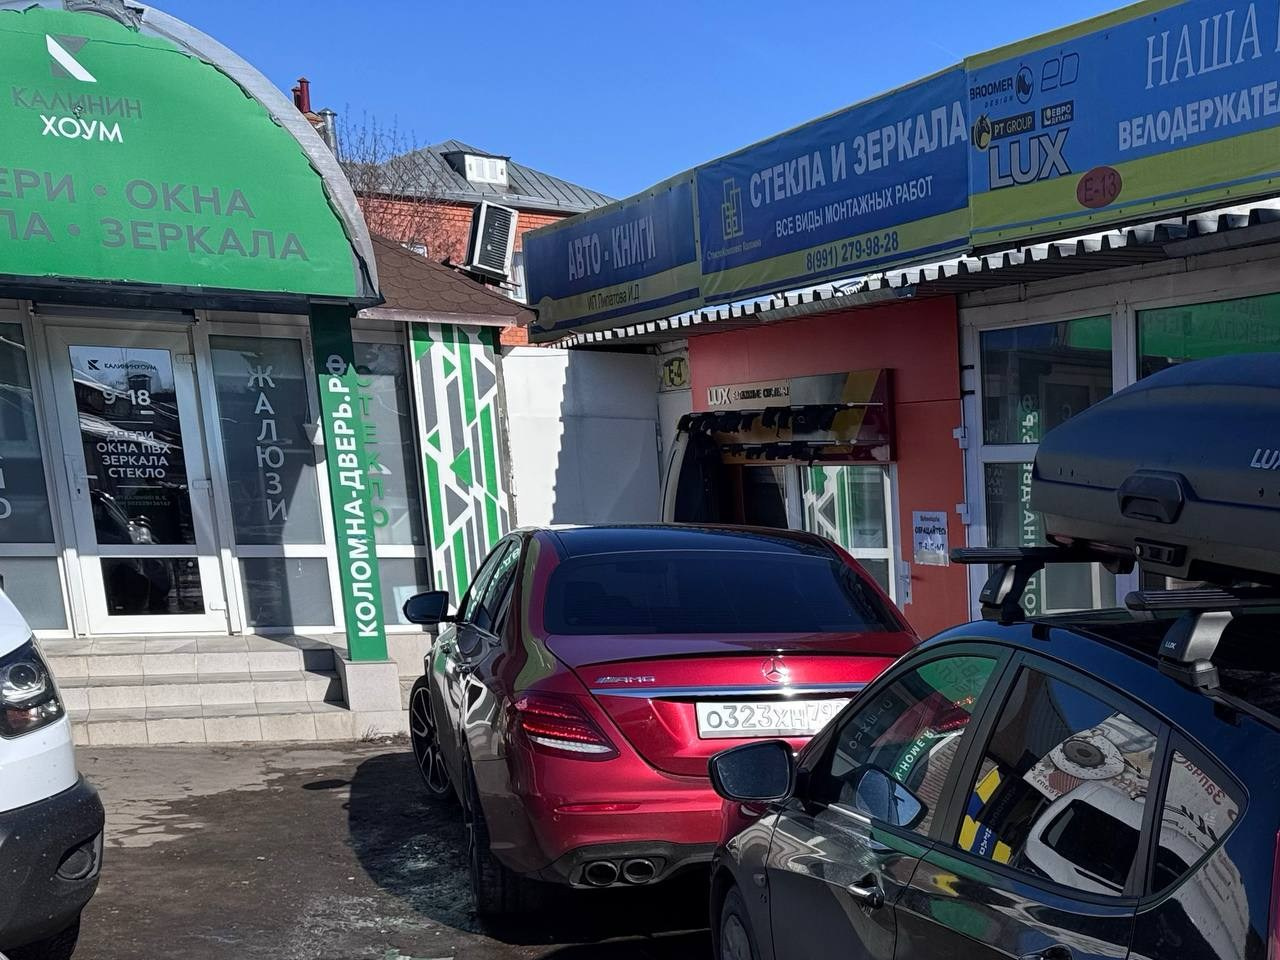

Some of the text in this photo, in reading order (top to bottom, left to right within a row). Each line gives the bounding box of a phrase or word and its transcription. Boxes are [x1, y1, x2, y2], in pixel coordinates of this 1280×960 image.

[1145, 7, 1263, 90] НАША
[12, 86, 143, 119] КАЛИНИН
[969, 77, 1014, 100] BROOMER
[40, 114, 123, 143] ХОУМ
[994, 116, 1033, 136] PT GROUP
[1051, 105, 1072, 117] ЕВРО
[750, 101, 968, 209] СТЕКЛА И ЗЕРКАЛА
[989, 128, 1072, 191] LUX
[125, 179, 257, 219] ОКНА
[776, 175, 933, 238] ВСЕ ВИДЫ МОНТАЖНЫХ РАБОТ
[99, 217, 310, 262] ЗЕРКАЛА
[568, 233, 601, 281] АВТО
[611, 215, 656, 270] КНИГИ
[806, 231, 899, 273] 8(991) 279-98-28
[707, 386, 732, 406] LUX
[96, 442, 172, 454] ОКНА ПВХ
[102, 455, 169, 466] ЗЕРКАЛА
[248, 364, 287, 522] ЖАЛЮЗИ
[108, 467, 166, 478] СТЕКЛО
[326, 354, 379, 638] КОЛОМНА-ДВЕРЬ.РФ
